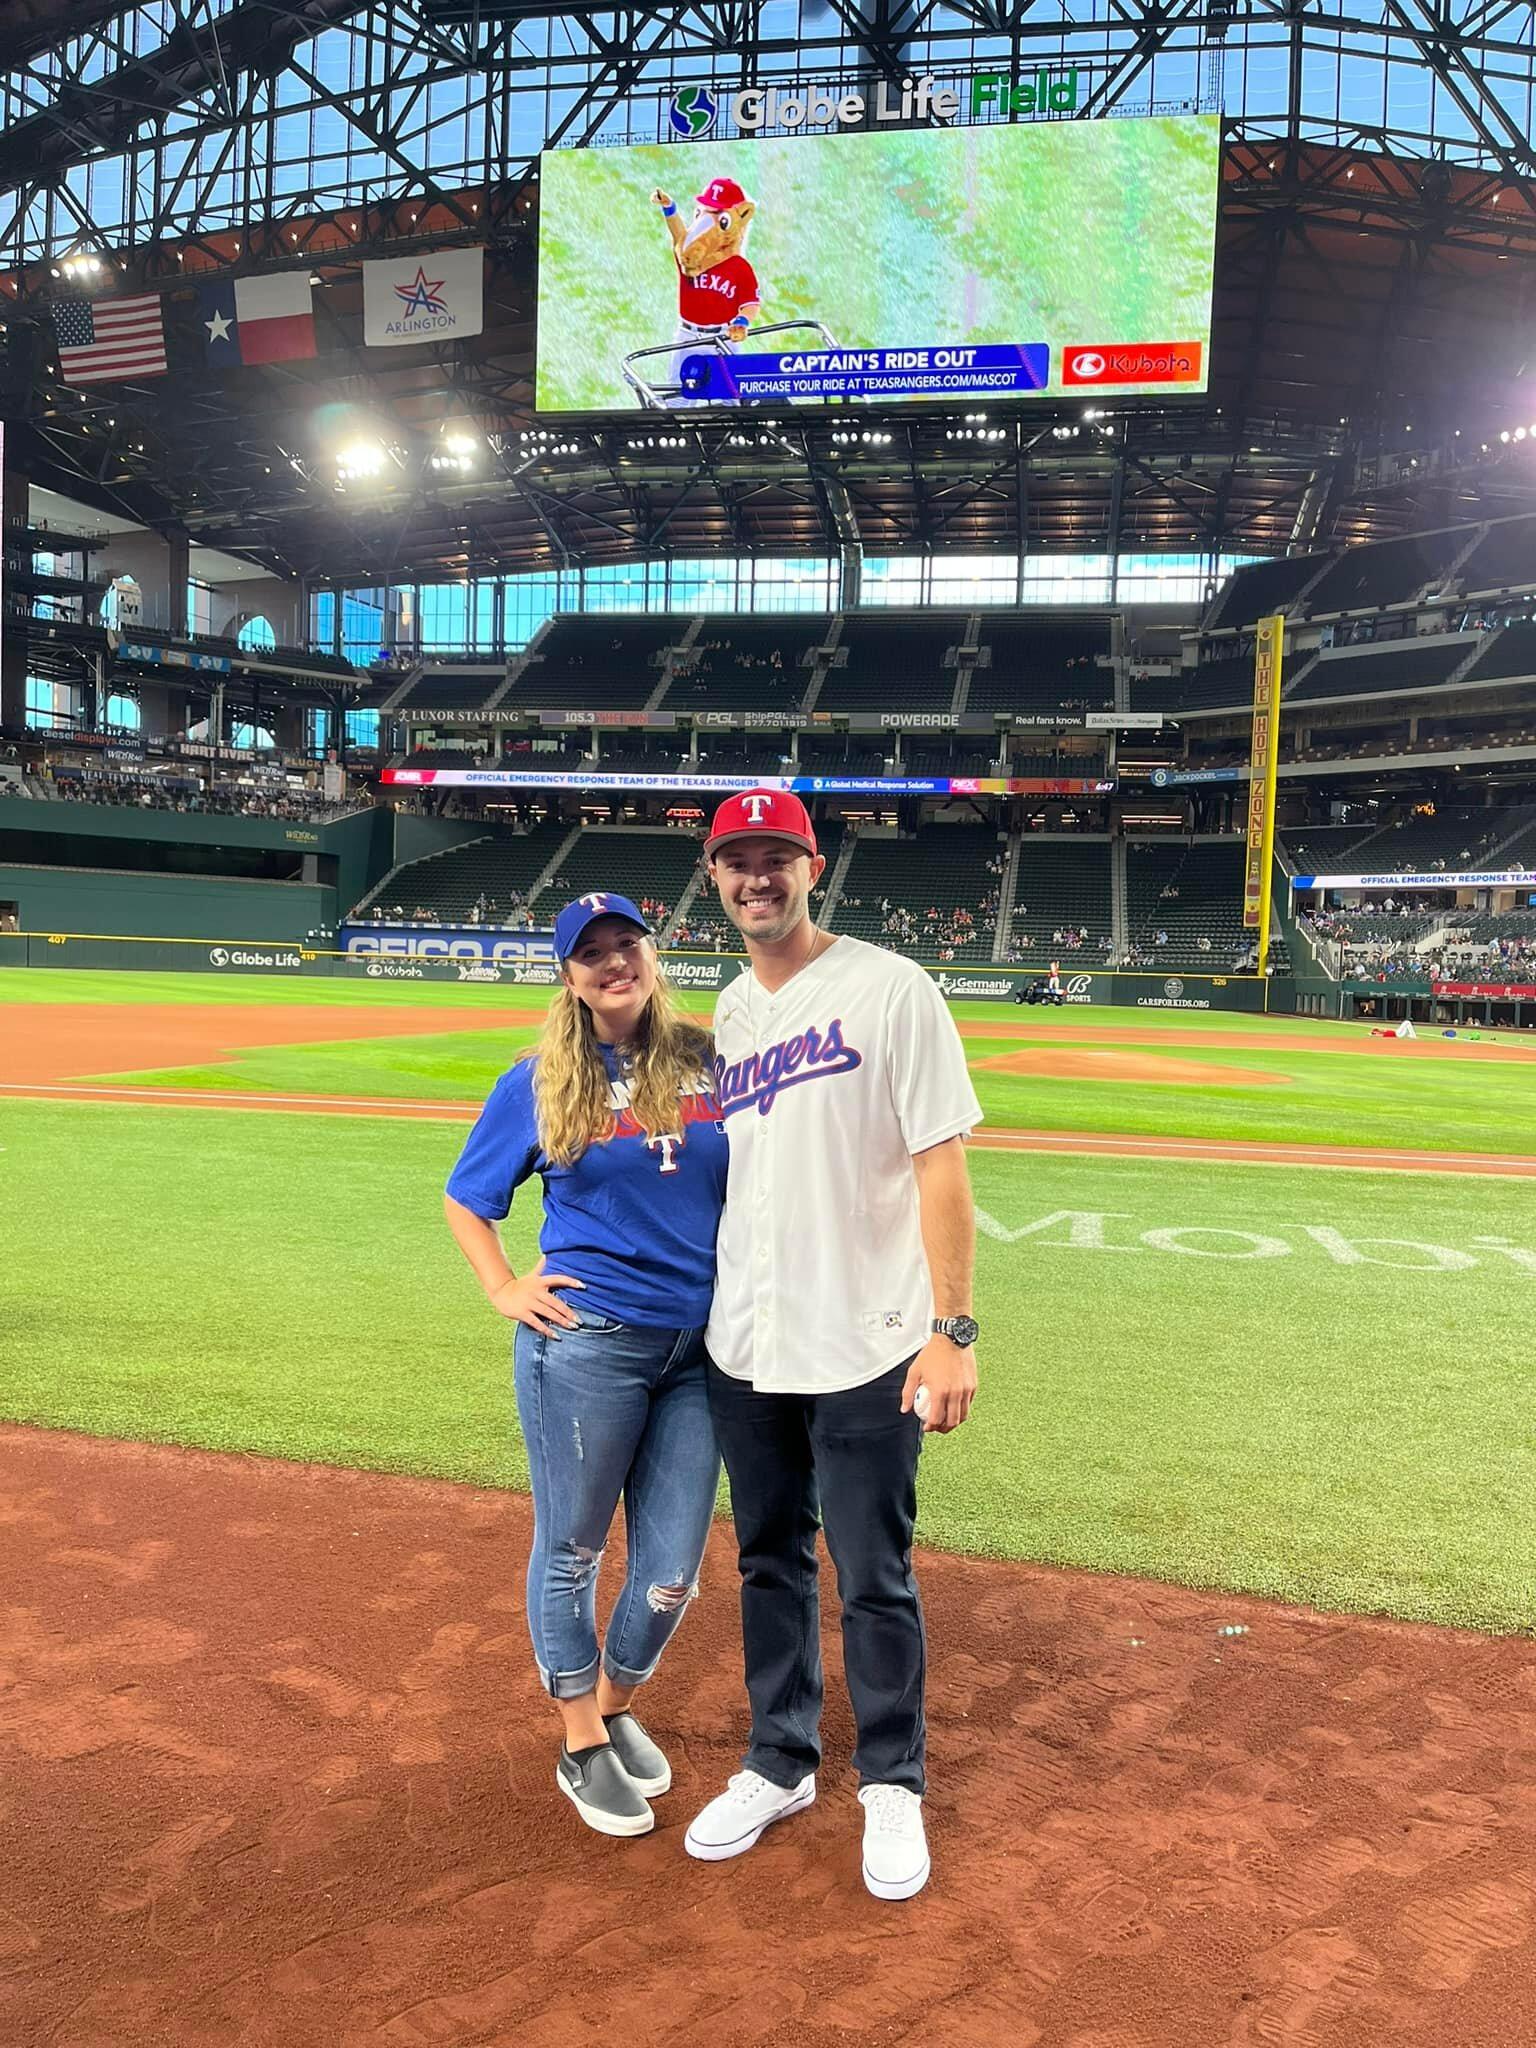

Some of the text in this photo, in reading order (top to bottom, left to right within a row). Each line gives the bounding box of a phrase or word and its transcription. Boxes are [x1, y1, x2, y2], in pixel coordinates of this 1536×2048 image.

[732, 68, 1078, 130] Globe Life Field
[711, 184, 724, 201] T
[693, 273, 737, 299] TEXAS
[384, 315, 456, 334] ARLINGTON
[779, 350, 976, 373] CAPTAIN'S RIDE OUT
[1110, 352, 1193, 374] Kubota
[739, 373, 1017, 394] PURCHASE YOUR RIDE AT TEXASRANGERS.COM/MASCOT
[412, 711, 519, 722] LUXOR STAFFING
[565, 712, 595, 723] 105.3
[706, 712, 738, 724] PGL
[880, 714, 960, 727] POWERADE
[1015, 716, 1035, 725] Real
[1036, 716, 1054, 725] fans
[1055, 716, 1082, 725] know.
[42, 729, 141, 748] dieseldisplays.com
[180, 743, 216, 758] HART
[1251, 653, 1271, 847] THE HOT ZONE
[466, 774, 759, 787] OFFICIAL EMERGENCY RESPONSE TEAM OF THE TEXAS RANGERS
[741, 794, 771, 823] T
[1361, 873, 1536, 884] OFFICIAL EMERGENCY RESPONSE TEAM
[579, 892, 607, 913] T
[48, 936, 67, 945] 407
[231, 951, 301, 967] Globe Life
[300, 953, 316, 961] 410
[348, 936, 482, 967] GEICO
[384, 965, 424, 977] Kubota
[677, 977, 719, 986] Car Rental
[957, 977, 1014, 989] Germania
[1066, 995, 1091, 1003] SPORTS
[1137, 997, 1210, 1009] CARSFORKIDS.ORG
[648, 1133, 684, 1174] T
